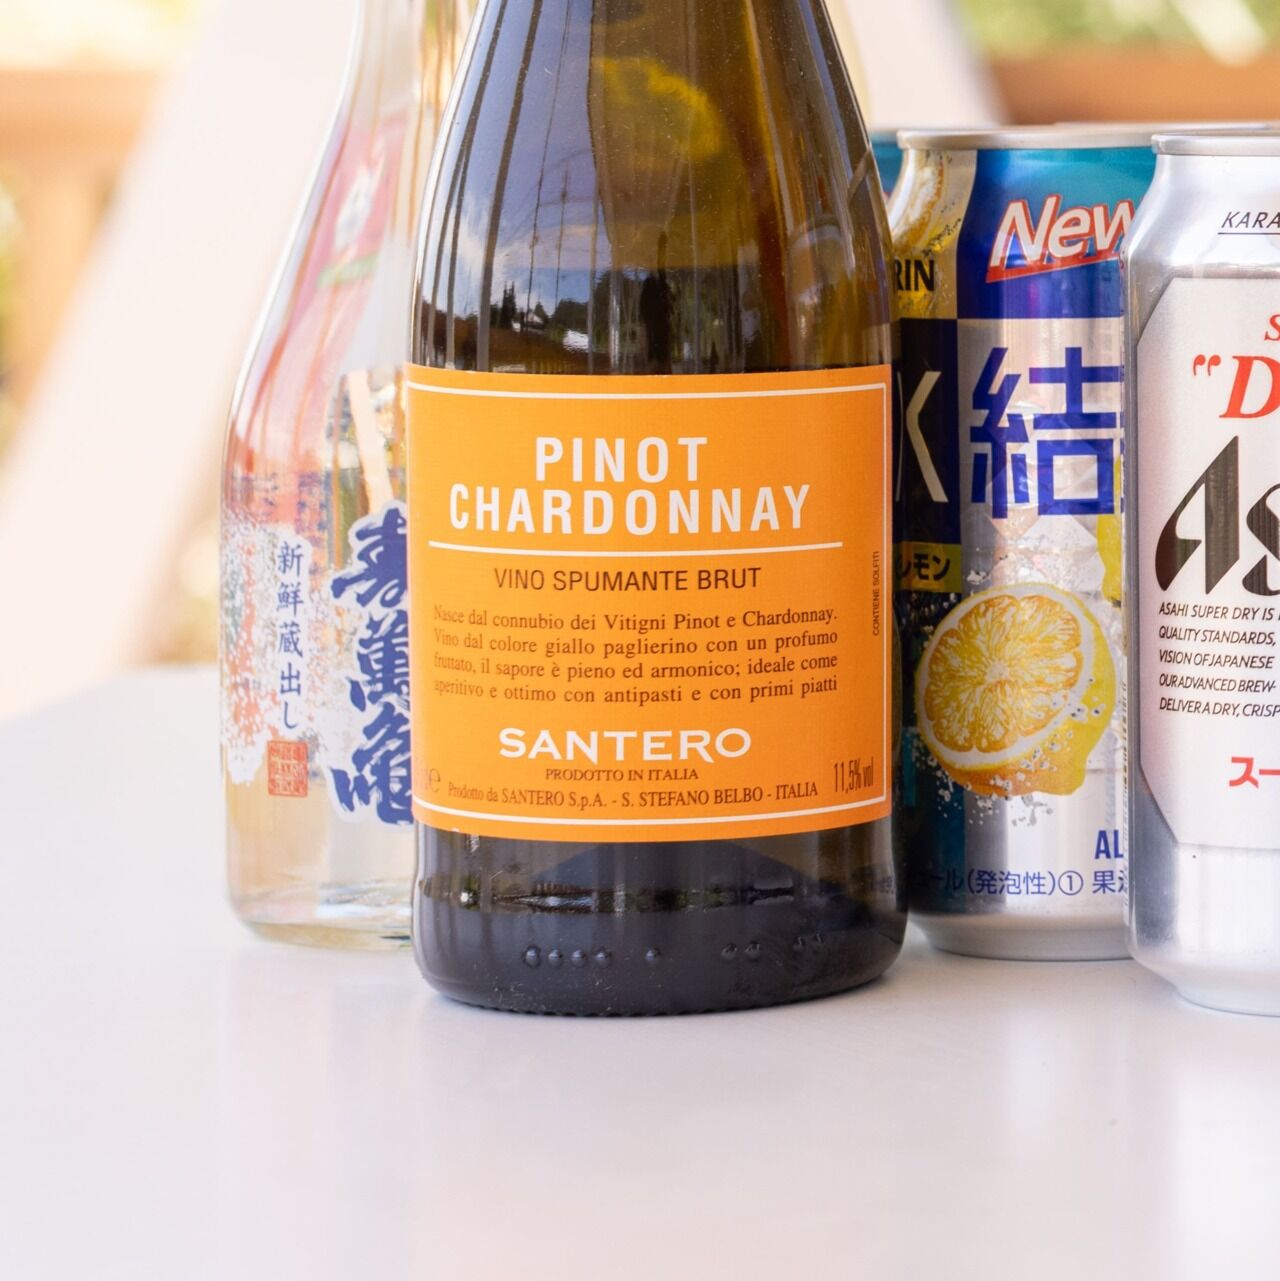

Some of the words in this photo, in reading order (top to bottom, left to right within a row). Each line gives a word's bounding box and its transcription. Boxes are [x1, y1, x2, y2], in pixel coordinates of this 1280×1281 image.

[988, 195, 1136, 269] New
[535, 436, 708, 483] PINOT
[449, 483, 811, 536] CHARDONNAY
[494, 568, 545, 590] VINO
[553, 569, 688, 592] SPUMANTE
[698, 568, 761, 590] BRUT
[872, 551, 880, 586] SOLFITI
[492, 613, 564, 630] connubio
[570, 614, 596, 630] dei
[604, 613, 665, 634] Vitigni
[674, 613, 720, 629] Pinot
[743, 607, 838, 627] Chardonnay.
[872, 589, 880, 637] CONTIENE
[1159, 602, 1188, 617] ASAHI
[1191, 604, 1228, 619] SUPER
[1232, 607, 1260, 621] DRY
[277, 541, 304, 730] 新鮮蔵出し
[489, 635, 537, 653] colore
[545, 637, 595, 658] giallo
[604, 638, 697, 659] paglierino
[706, 638, 738, 653] con
[775, 631, 838, 653] profumo
[1159, 625, 1201, 642] QUALITY
[1201, 629, 1276, 647] STANDARDS,
[496, 663, 545, 680] sapore
[567, 663, 616, 682] pieno
[622, 662, 643, 679] ed
[651, 661, 740, 679] armonico;
[748, 657, 795, 675] ideale
[801, 655, 838, 671] come
[1159, 649, 1193, 665] VISION
[504, 685, 556, 702] ottimo
[563, 689, 595, 702] con
[604, 687, 682, 707] antipasti
[710, 687, 741, 701] con
[750, 680, 793, 702] primi
[801, 675, 838, 699] piatti
[499, 727, 751, 765] SANTERO
[545, 768, 624, 782] PRODOTTO
[647, 768, 699, 782] ITALIA
[834, 758, 861, 795] 11,5%
[863, 756, 874, 789] vol
[501, 788, 565, 807] SANTERO
[639, 790, 709, 807] STEFANO
[714, 786, 763, 805] BELBO
[776, 782, 818, 801] ITALIA
